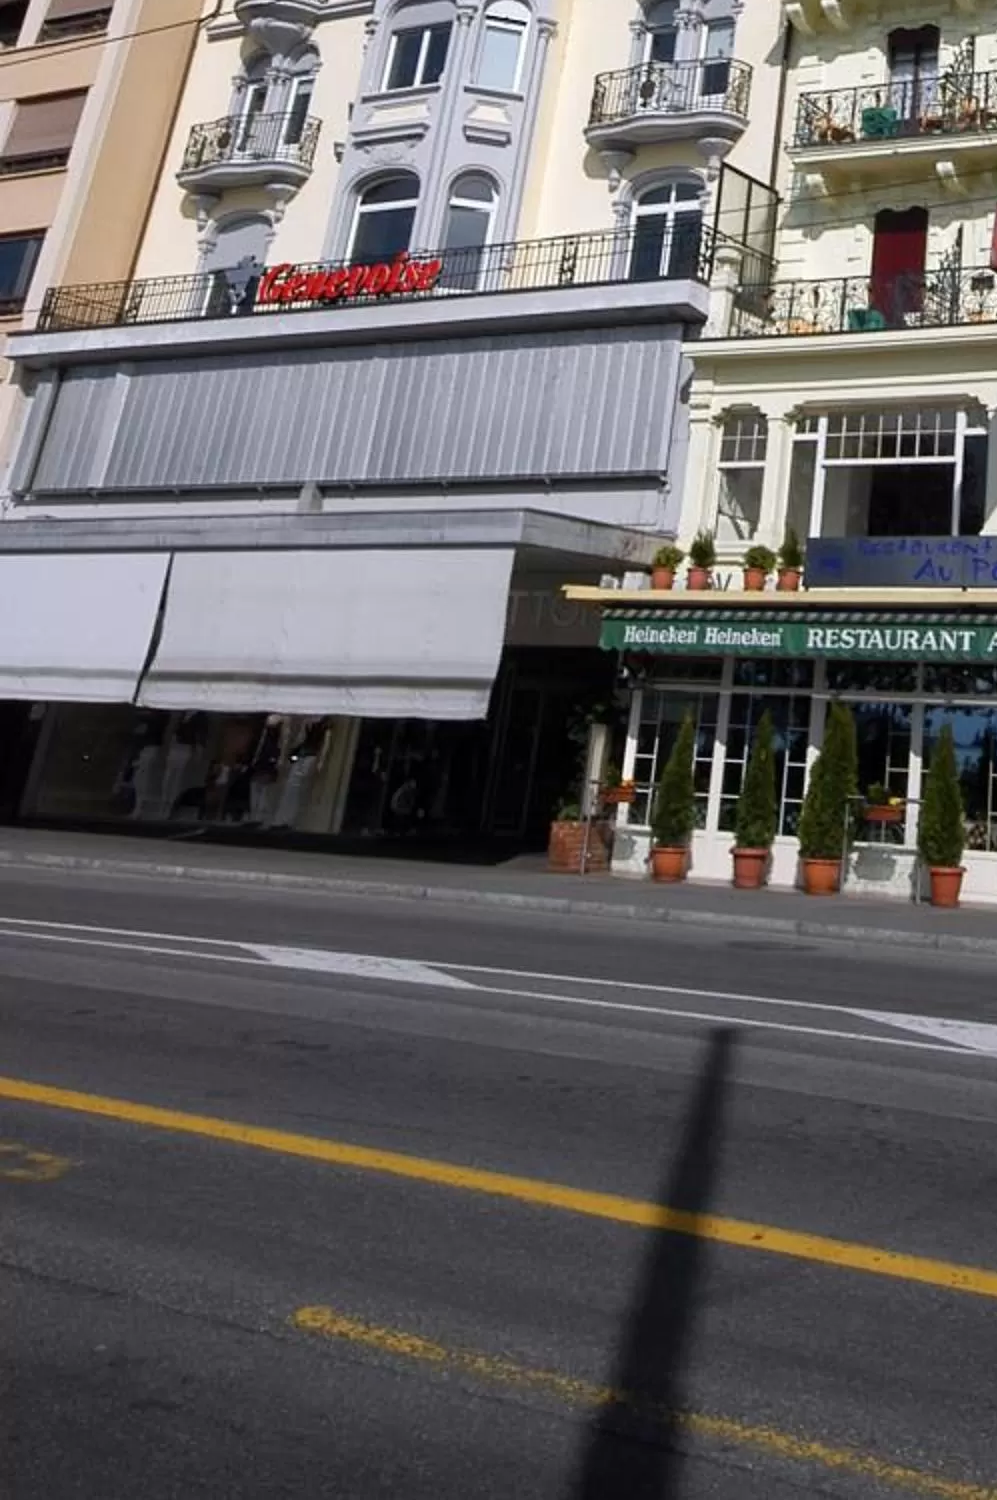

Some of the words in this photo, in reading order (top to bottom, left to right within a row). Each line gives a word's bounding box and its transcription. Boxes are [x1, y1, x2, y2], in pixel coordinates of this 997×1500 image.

[257, 251, 442, 304] Genevoise
[624, 625, 699, 644] Heineken
[704, 627, 783, 646] Heineken
[806, 628, 976, 651] RESTAURANT
